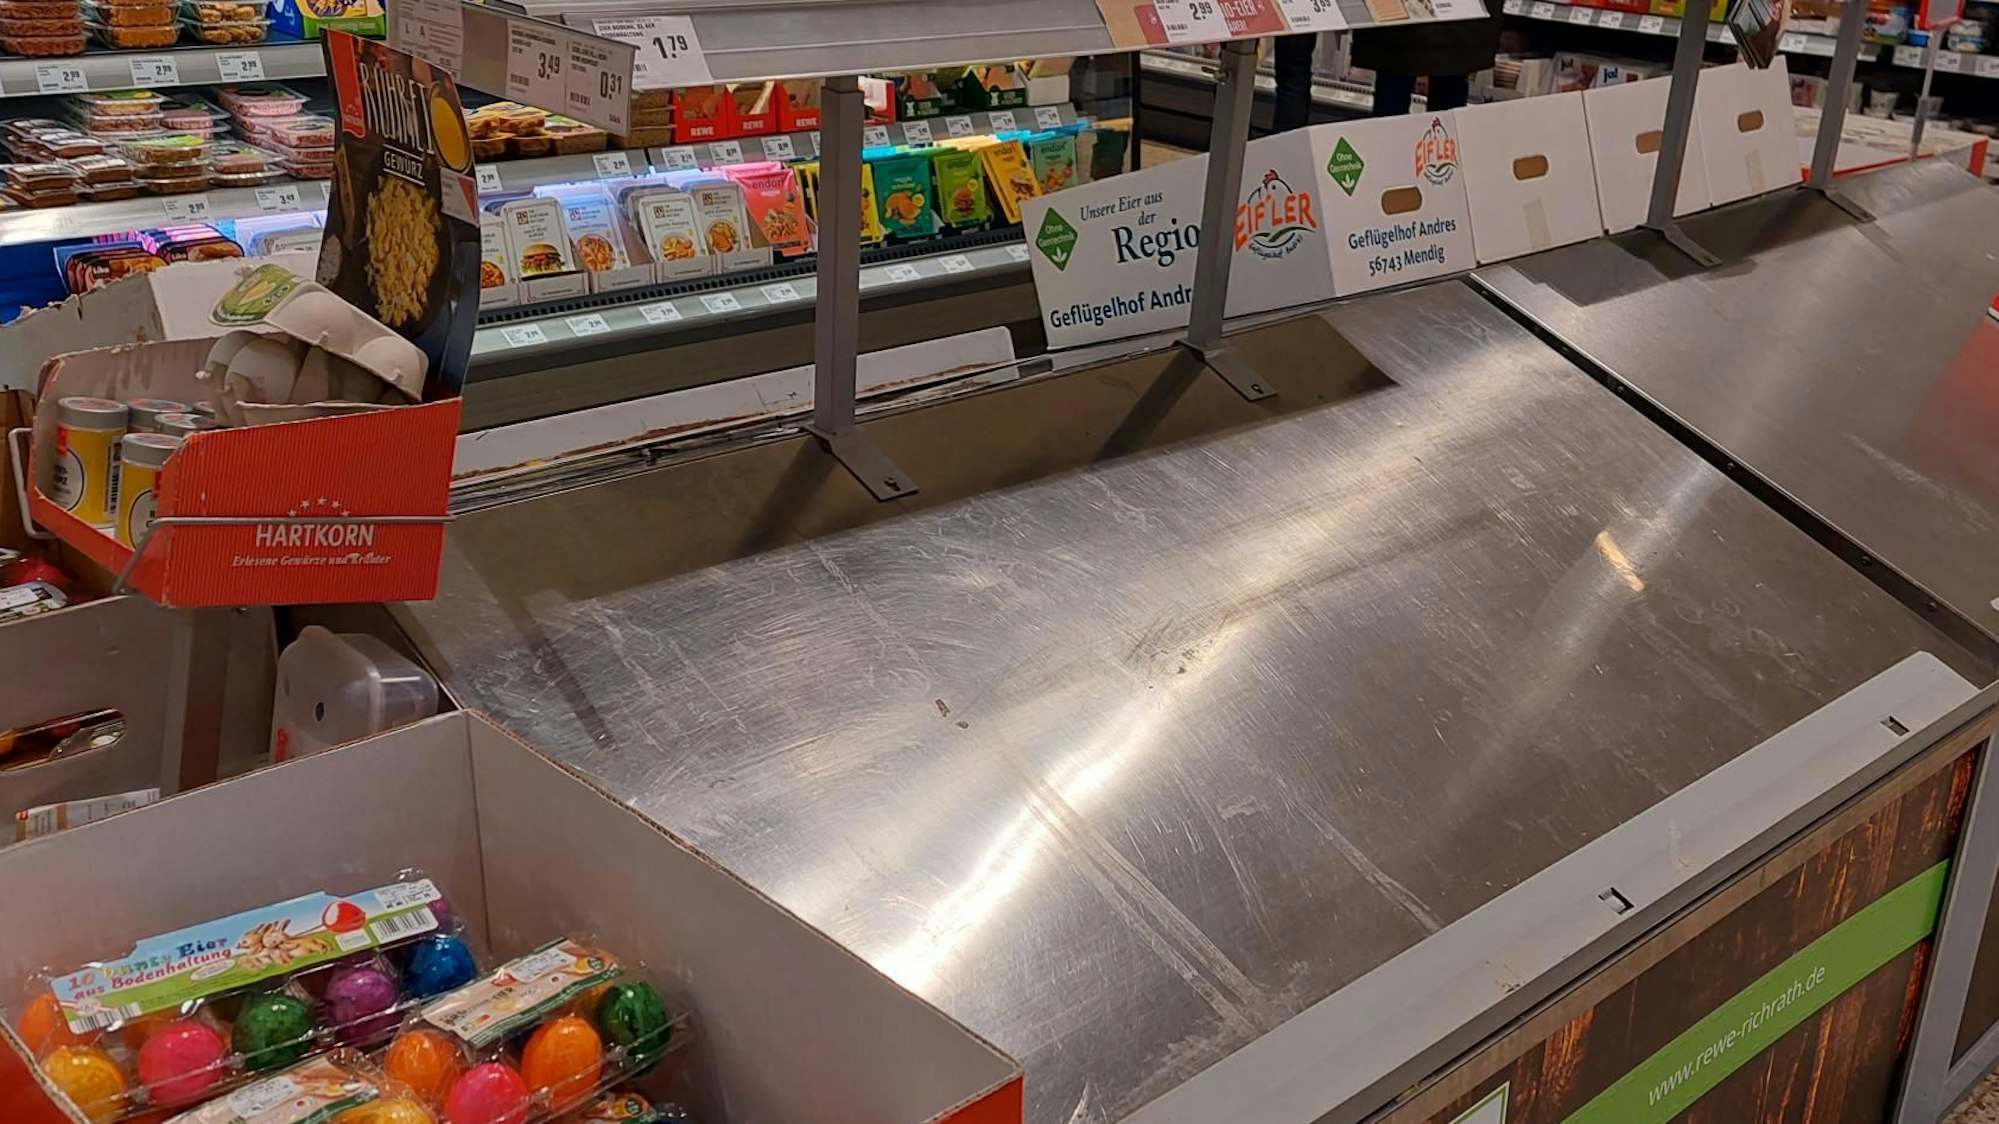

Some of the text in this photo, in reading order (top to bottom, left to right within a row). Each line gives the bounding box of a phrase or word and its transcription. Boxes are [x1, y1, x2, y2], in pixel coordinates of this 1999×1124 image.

[1190, 2, 1213, 20] 2.99
[652, 35, 688, 59] 1.79
[62, 70, 80, 82] 2.99
[155, 64, 172, 76] 2.99
[241, 60, 257, 72] 2.99
[538, 52, 560, 80] 3.49
[1603, 67, 1619, 83] ja!
[600, 71, 622, 100] 0.31
[691, 126, 715, 136] REWE
[743, 120, 764, 130] REWE
[796, 117, 818, 127] REWE
[383, 151, 424, 179] GEWÜRZ
[1336, 153, 1352, 162] Ohne
[1413, 137, 1458, 178] EIFLER
[1080, 191, 1163, 221] Unsere Eier aus
[1045, 224, 1063, 234] Ohne
[1138, 211, 1157, 226] der
[1234, 192, 1318, 252] EIFLER
[1112, 217, 1200, 268] Regio
[1348, 216, 1456, 250] Geflügelhof Andres
[1369, 244, 1446, 276] 56743 Mendig
[1050, 291, 1145, 328] Geflügelhof
[255, 524, 375, 547] HARTKORN
[232, 551, 392, 567] Erlesene Gewürze und Kräuter
[68, 972, 95, 991] 10
[175, 937, 228, 959] Eier
[73, 948, 232, 1000] aus Bodenhaltung
[1649, 966, 1825, 1106] www.rewe-richrath.de
